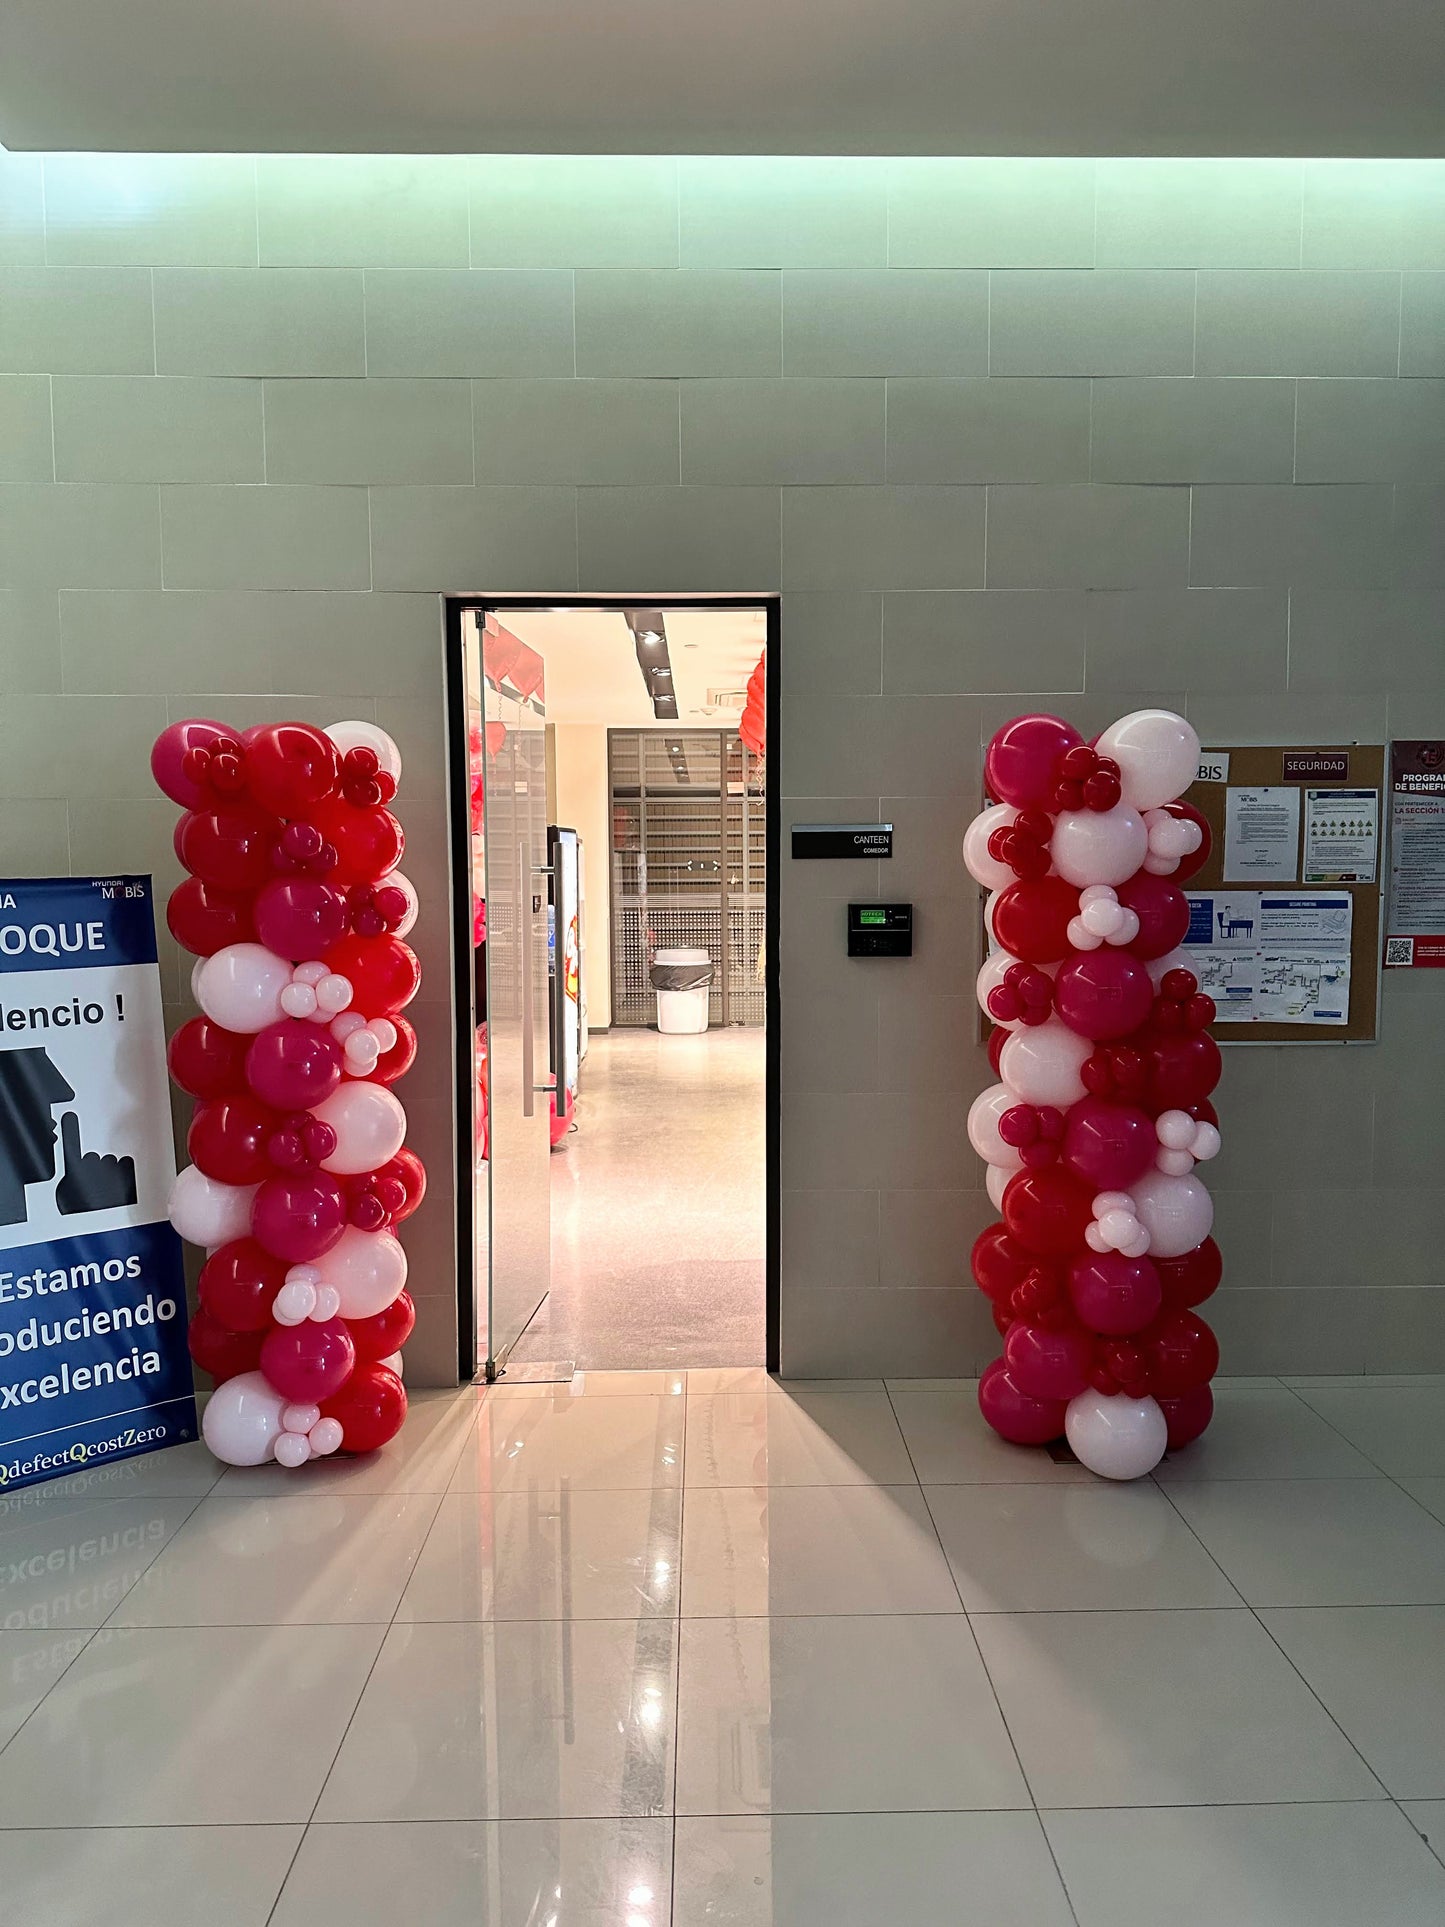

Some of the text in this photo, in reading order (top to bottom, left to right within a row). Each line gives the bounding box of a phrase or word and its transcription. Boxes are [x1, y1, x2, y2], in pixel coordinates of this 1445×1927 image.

[1196, 765, 1222, 780] BIS
[1287, 761, 1345, 771] SEGURIDAD
[1394, 783, 1445, 791] DE BENEFI
[1405, 806, 1439, 814] SECCIÓN
[853, 835, 889, 845] CANTEEN
[0, 921, 106, 957] OQUE
[115, 994, 125, 1021] !
[0, 1254, 142, 1304] Estamos
[0, 1294, 177, 1357] oduciendo
[0, 1346, 161, 1410] xcelencia
